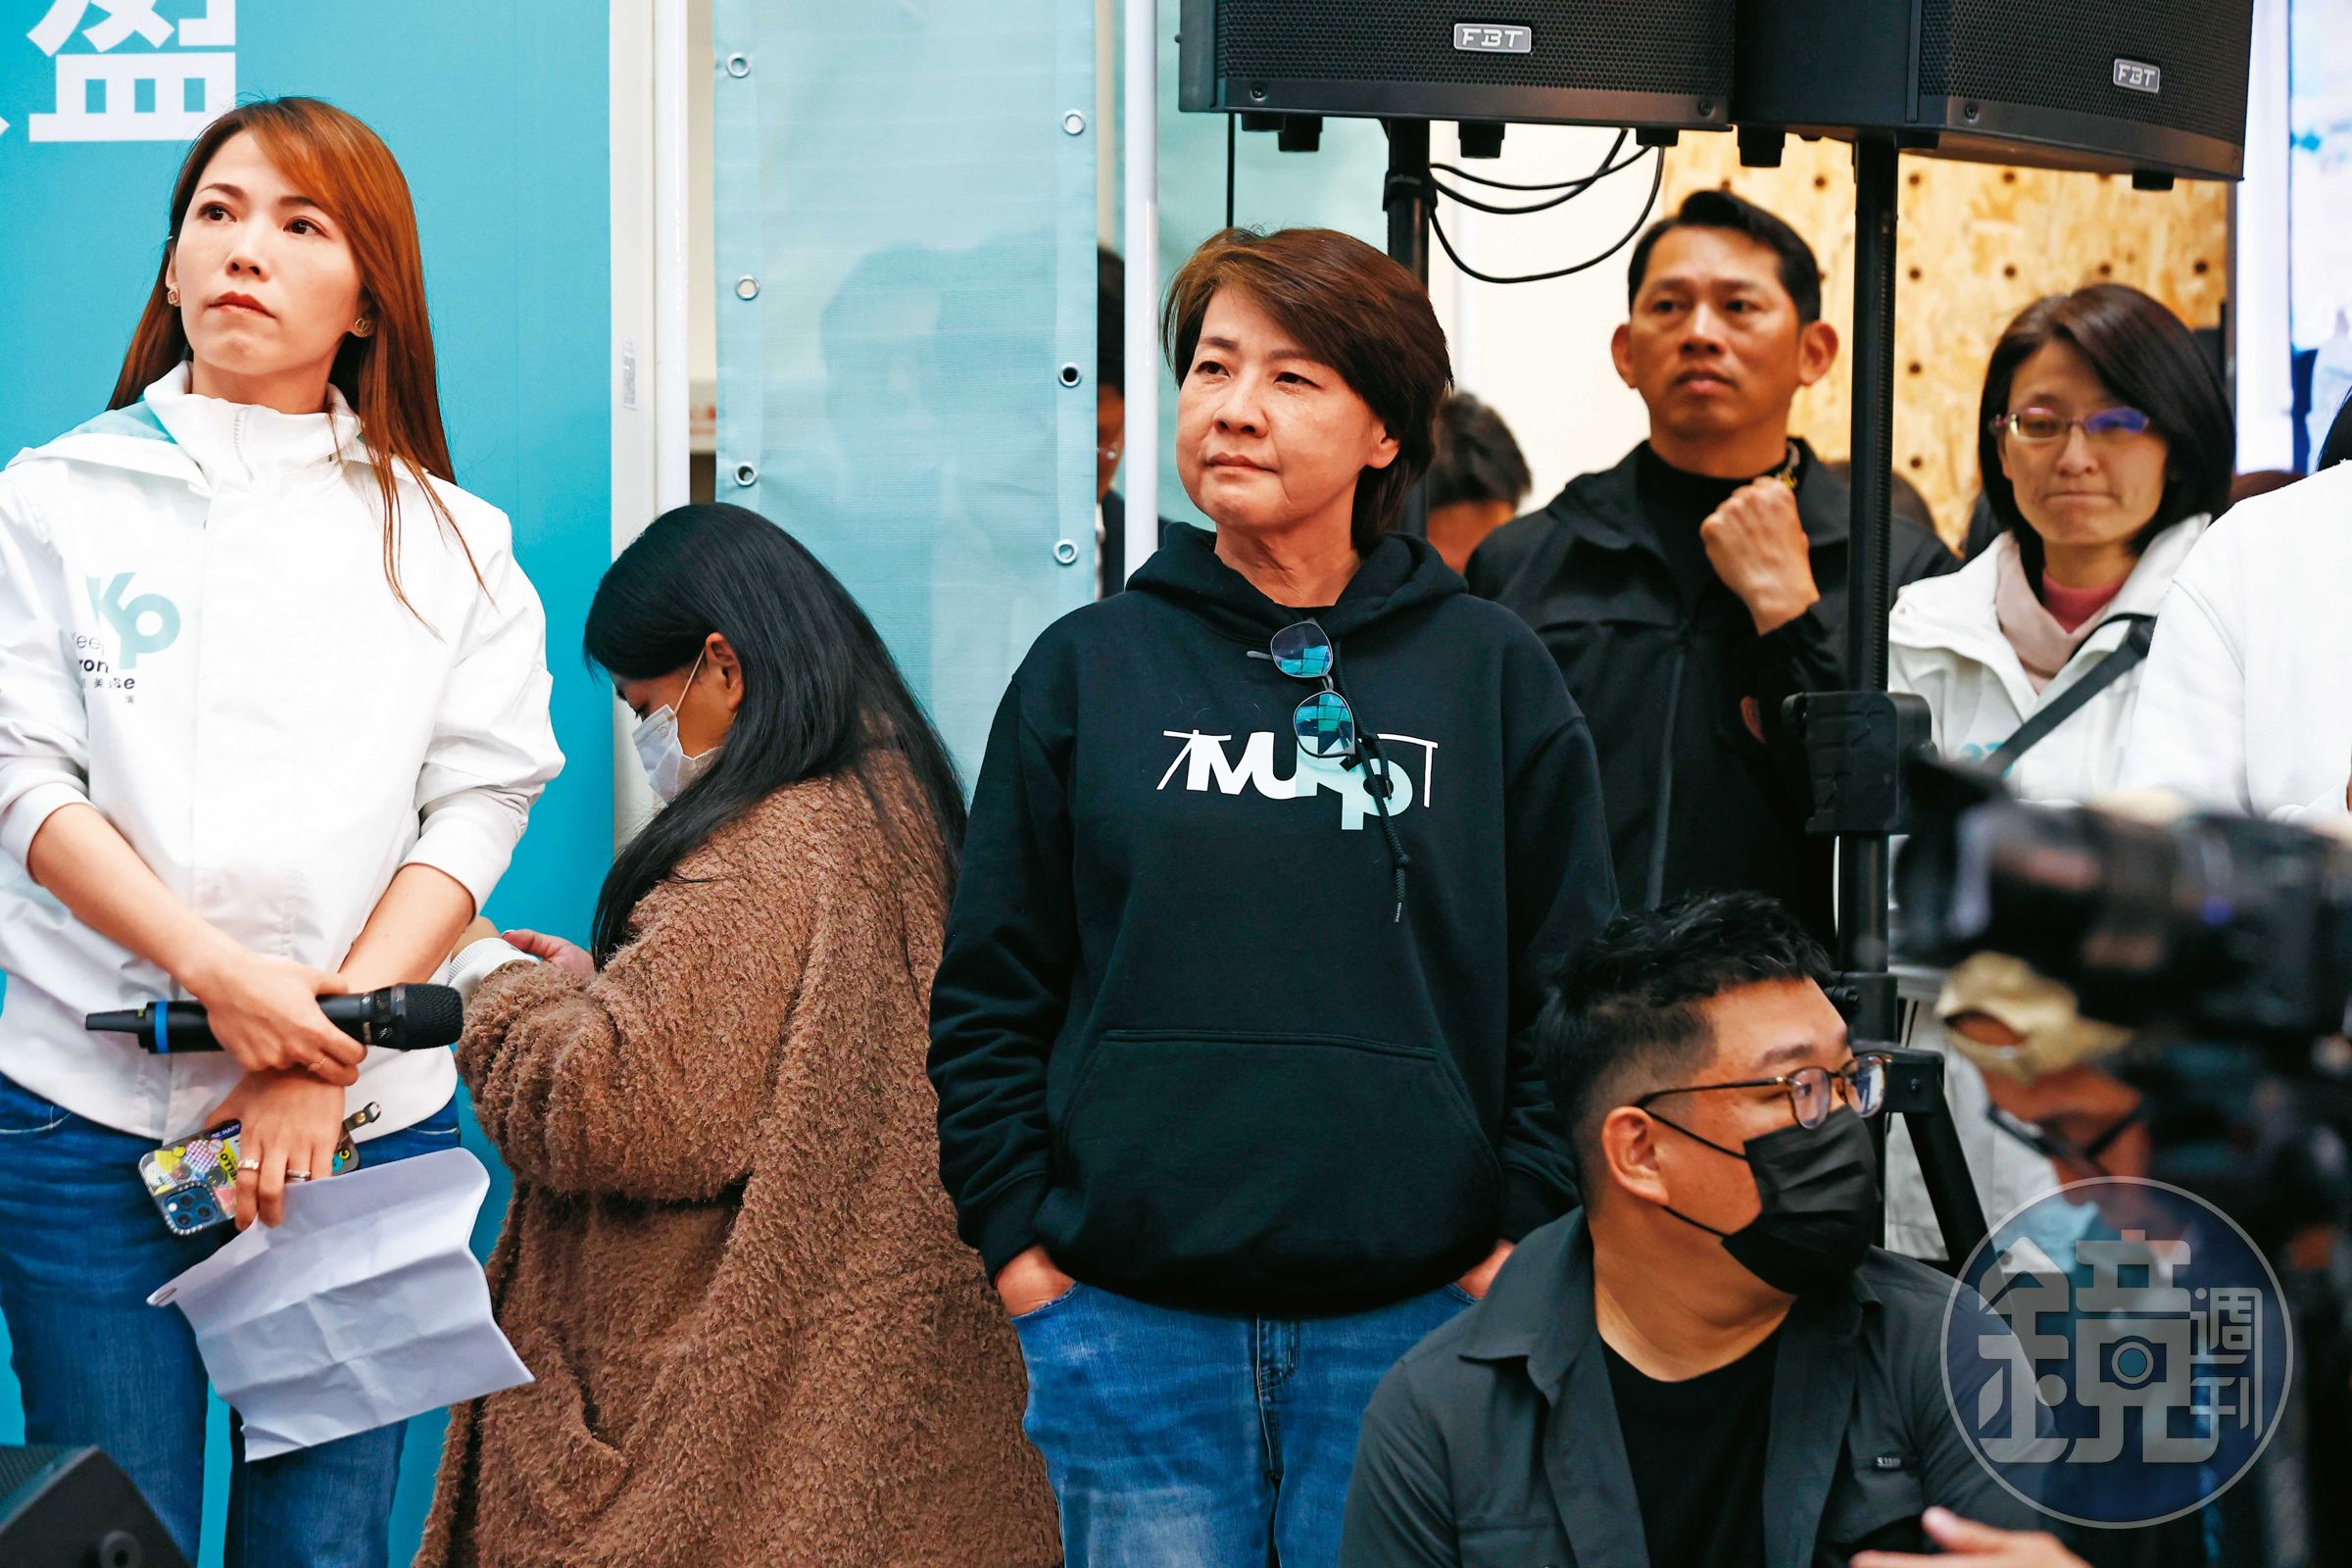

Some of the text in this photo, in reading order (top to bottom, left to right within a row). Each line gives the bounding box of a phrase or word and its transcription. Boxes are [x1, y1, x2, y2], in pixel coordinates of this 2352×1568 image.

[1462, 27, 1524, 48] FBT
[0, 0, 236, 142] 盈
[2118, 63, 2156, 86] FBT
